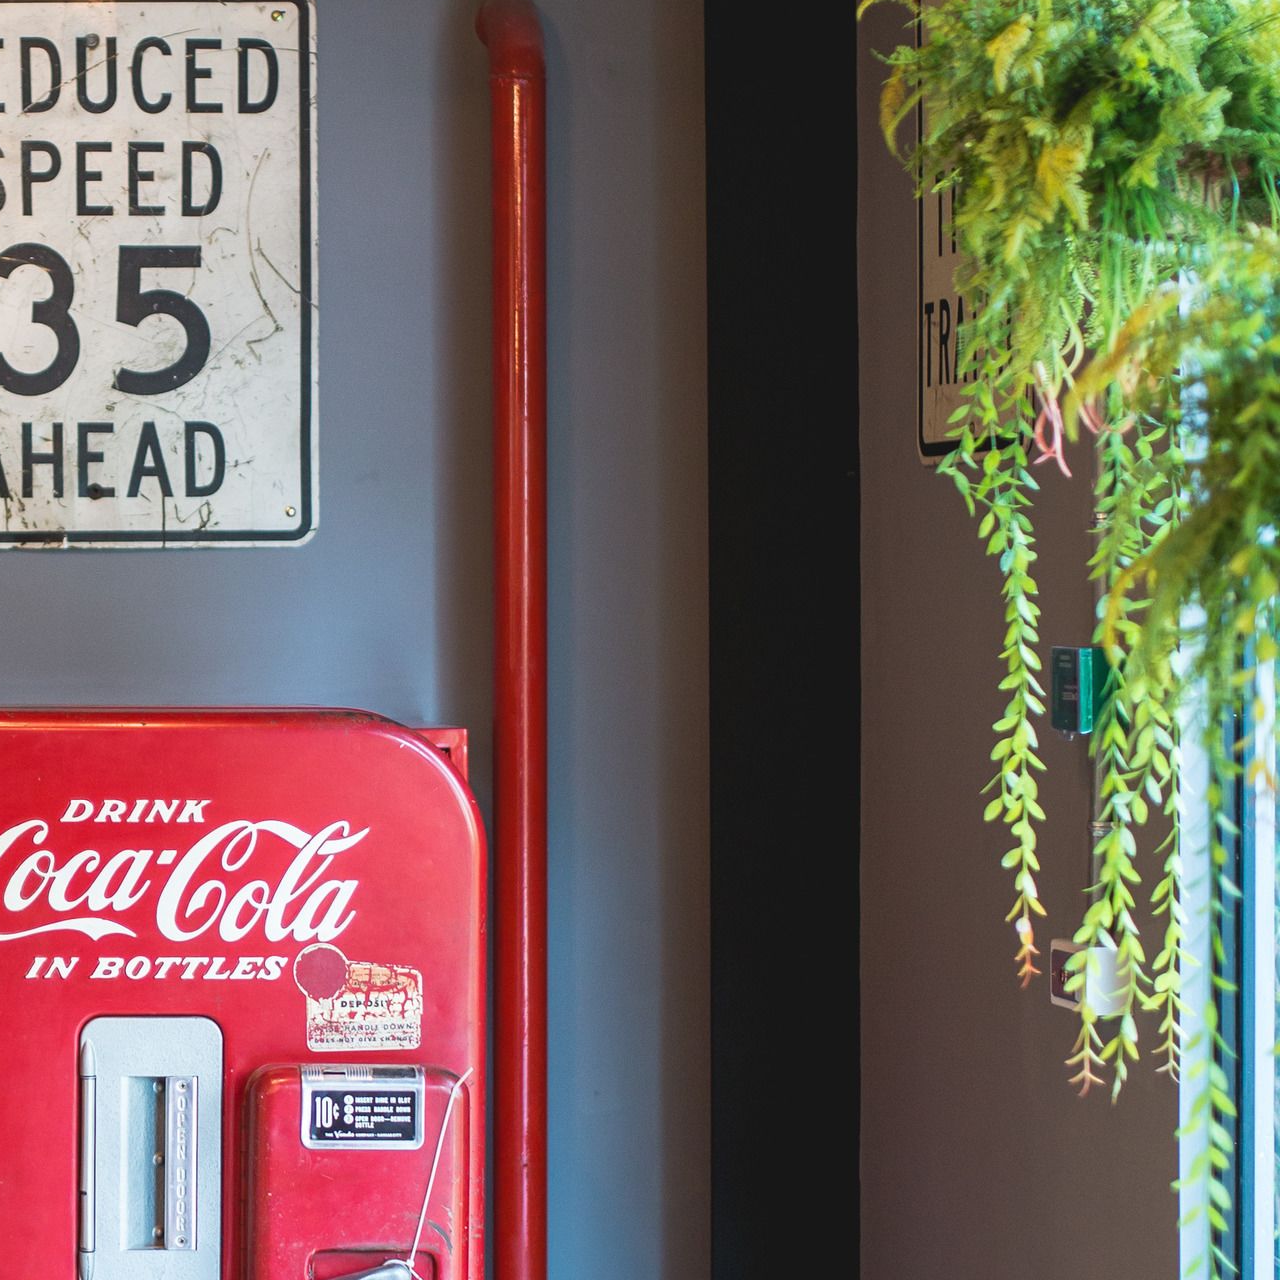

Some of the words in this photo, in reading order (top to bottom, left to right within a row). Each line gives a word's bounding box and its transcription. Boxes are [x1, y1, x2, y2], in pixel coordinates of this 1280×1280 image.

[60, 799, 212, 823] DRINK
[24, 956, 80, 980] IN
[89, 955, 290, 981] BOTTLES
[176, 1095, 186, 1160] OPEN
[176, 1166, 186, 1231] DOOR
